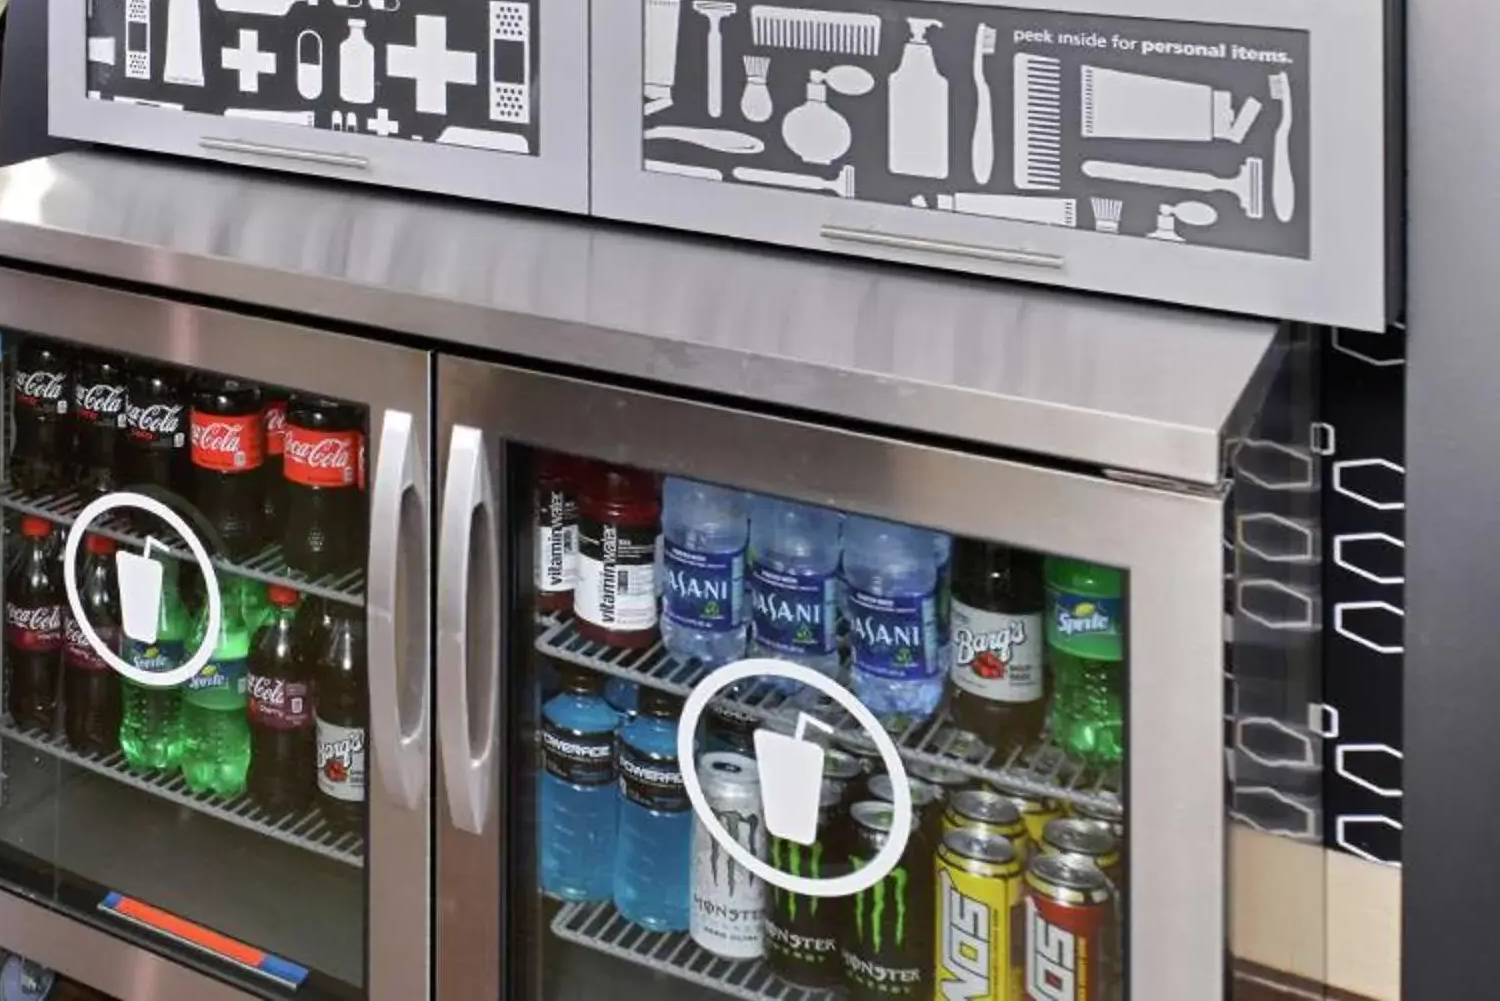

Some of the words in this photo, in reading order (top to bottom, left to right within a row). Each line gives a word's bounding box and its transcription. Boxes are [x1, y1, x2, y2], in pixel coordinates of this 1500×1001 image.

[1012, 28, 1054, 45] peek
[1057, 31, 1107, 49] inside
[1111, 34, 1138, 51] for
[1140, 37, 1226, 60] personal
[1231, 43, 1294, 65] items.
[754, 589, 820, 624] ASANI
[1058, 611, 1110, 635] Sprite
[851, 615, 921, 647] ASANI
[955, 619, 1027, 667] Barq's
[765, 918, 837, 952] ONSTER
